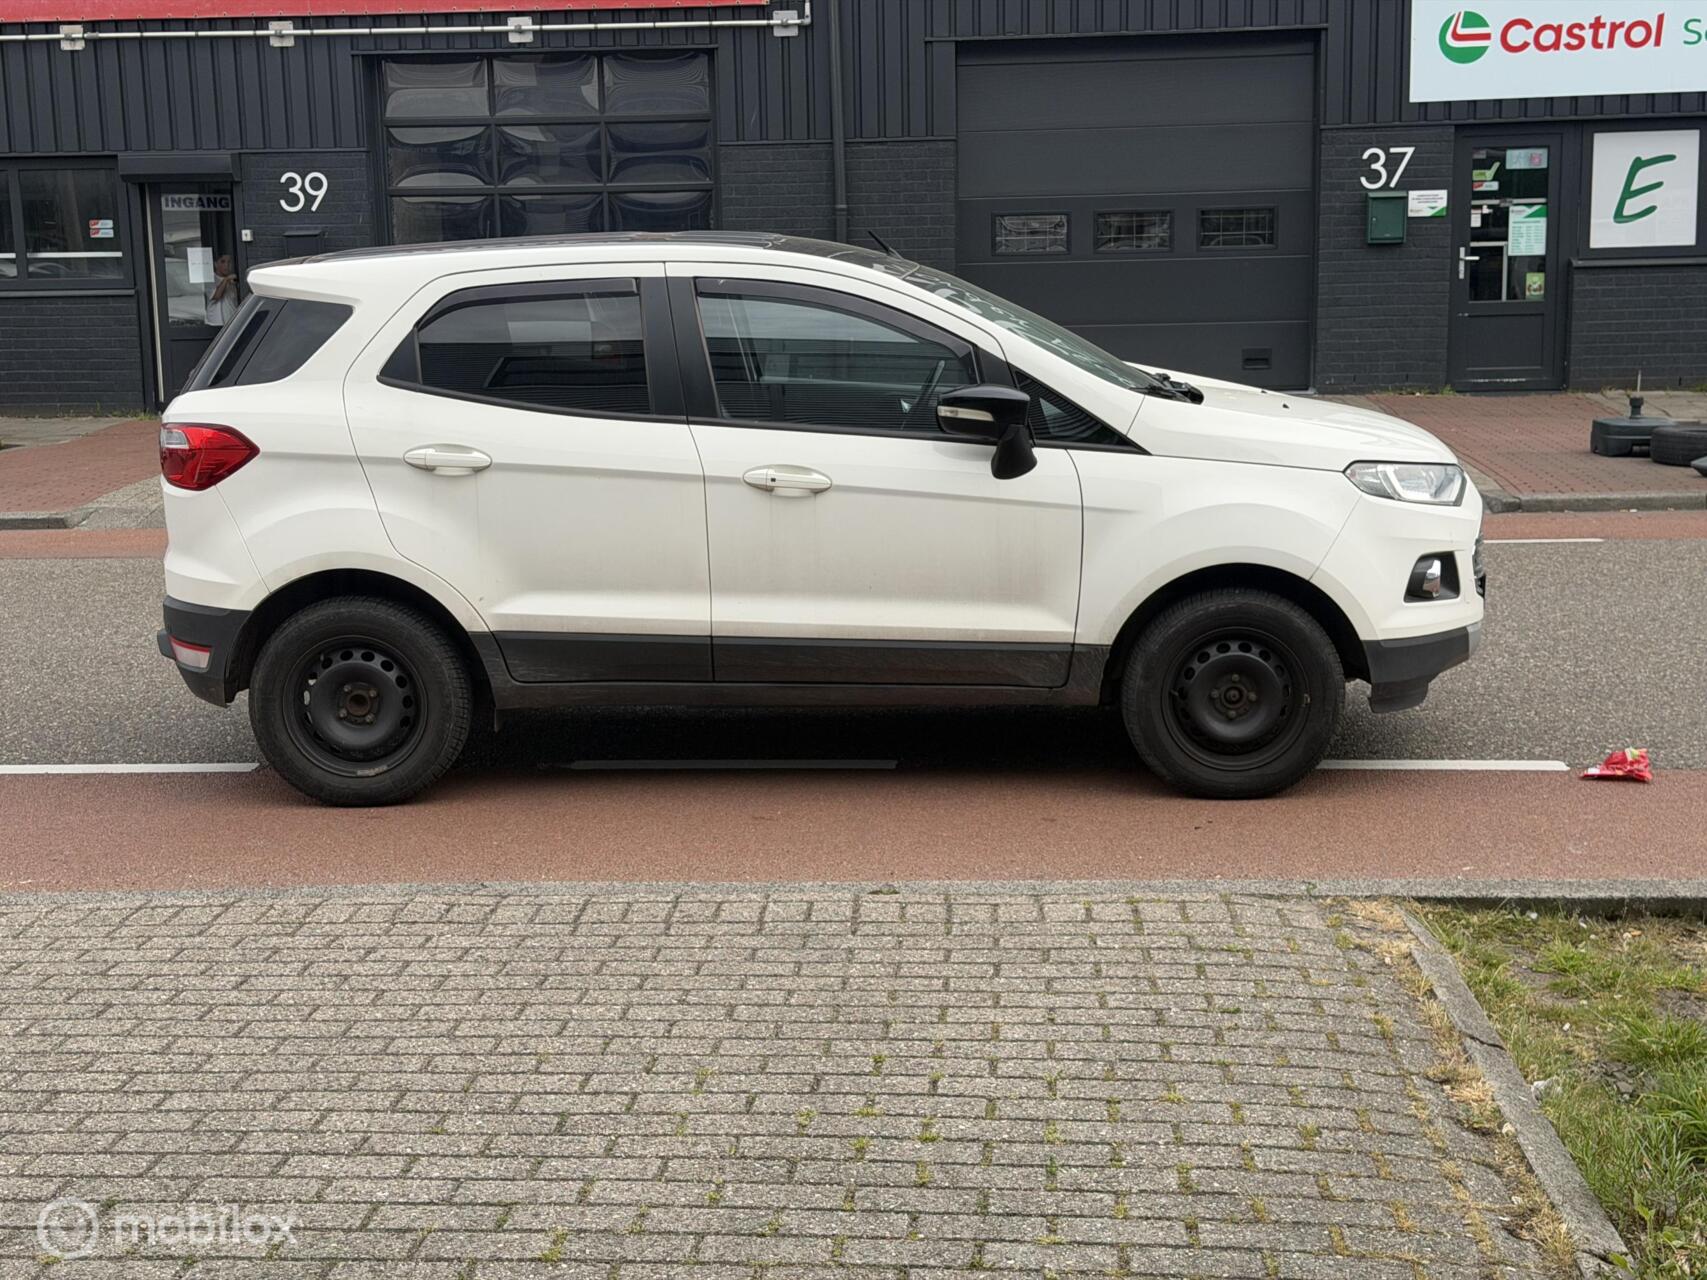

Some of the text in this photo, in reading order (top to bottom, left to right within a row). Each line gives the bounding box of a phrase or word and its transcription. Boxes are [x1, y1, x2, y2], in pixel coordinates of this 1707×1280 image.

[1500, 13, 1665, 53] Castrol
[1360, 146, 1416, 190] 37
[164, 197, 230, 209] INGANG
[279, 172, 328, 212] 39
[1612, 154, 1677, 224] E
